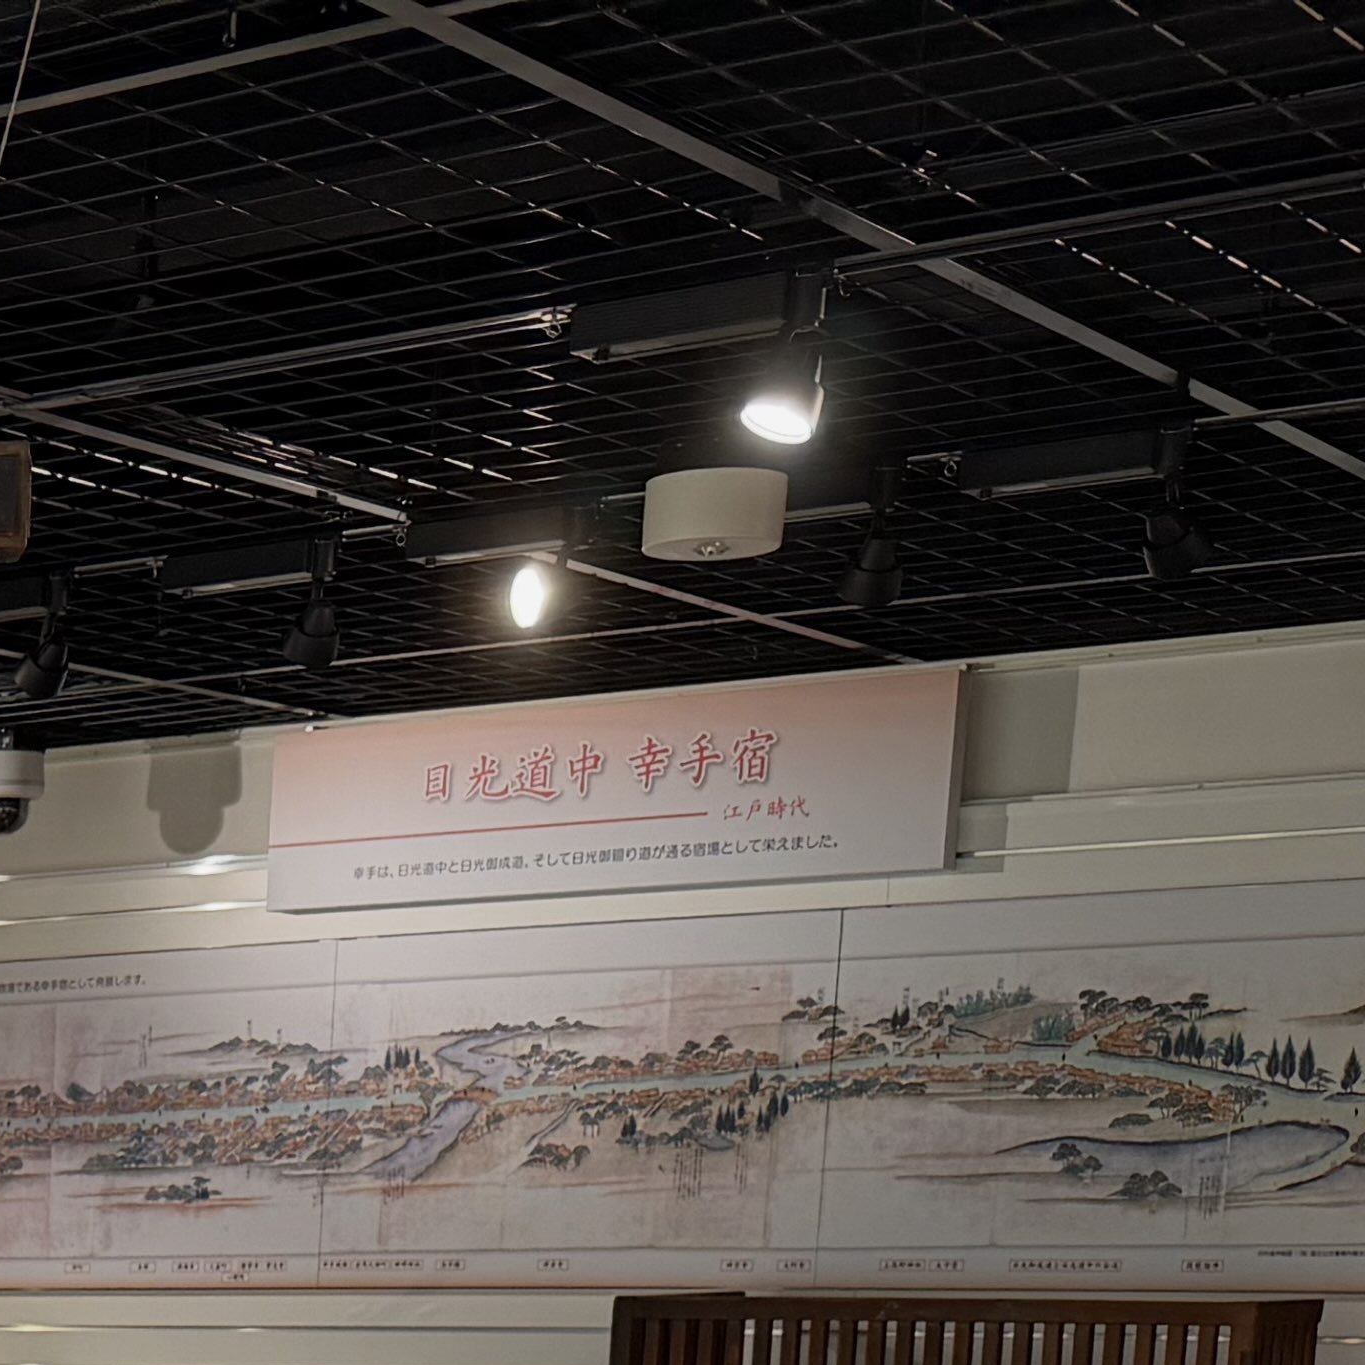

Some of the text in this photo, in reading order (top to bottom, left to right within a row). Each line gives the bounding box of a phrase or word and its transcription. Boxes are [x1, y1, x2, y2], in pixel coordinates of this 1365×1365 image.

[425, 728, 776, 800] 日光道中 幸手宿
[723, 797, 810, 820] 江戸時代
